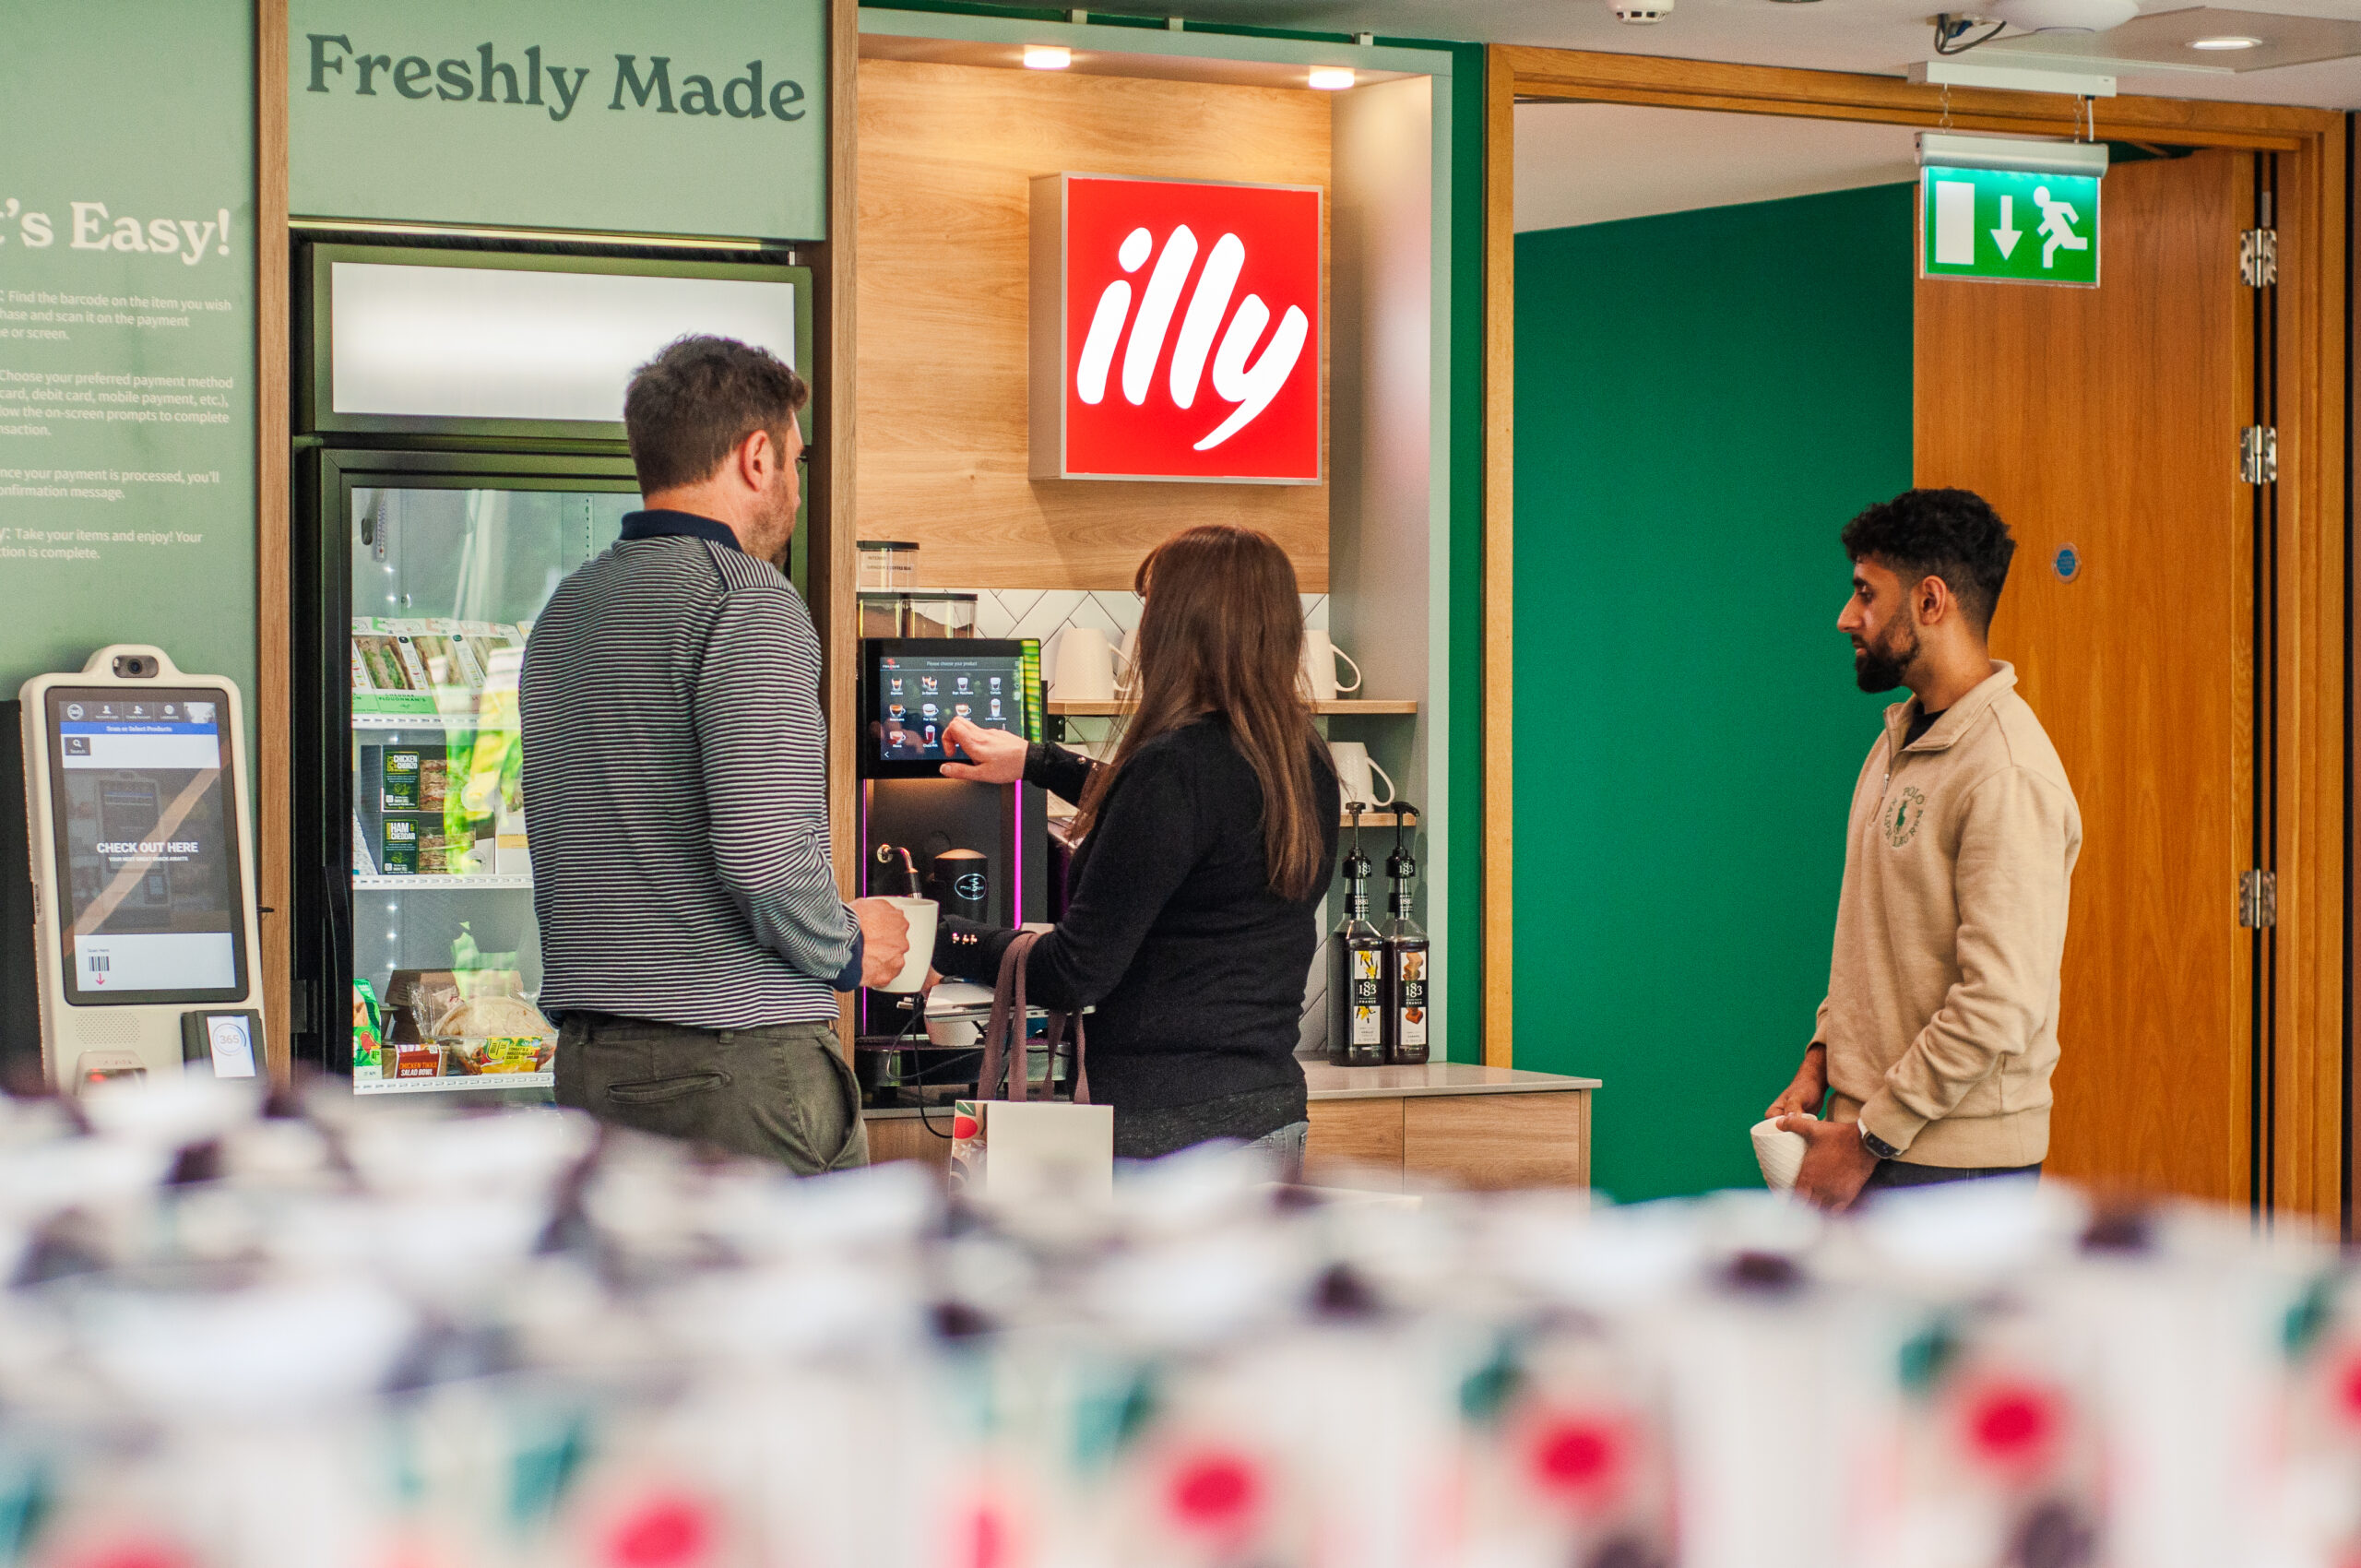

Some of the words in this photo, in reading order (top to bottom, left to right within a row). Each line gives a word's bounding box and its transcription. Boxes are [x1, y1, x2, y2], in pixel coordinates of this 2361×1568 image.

[306, 33, 589, 122] Freshly
[608, 54, 807, 122] Made
[0, 197, 53, 248] 's
[70, 200, 230, 266] Easy!
[8, 291, 35, 303] Find
[38, 291, 57, 303] the
[60, 291, 110, 306] barcode
[112, 296, 127, 306] on
[130, 295, 148, 307] the
[151, 296, 178, 309] item
[181, 301, 202, 312] you
[205, 299, 232, 311] wish
[30, 310, 53, 322] and
[55, 313, 83, 323] scan
[86, 312, 95, 324] it
[97, 314, 112, 324] on
[114, 313, 134, 325] the
[136, 315, 190, 328] payment
[11, 328, 25, 338] or
[27, 329, 70, 339] screen.
[1076, 224, 1309, 451] illy
[0, 369, 42, 382] Choose
[44, 374, 73, 385] your
[76, 372, 131, 386] preferred
[133, 375, 185, 388] payment
[188, 375, 233, 388] method
[31, 388, 64, 400] debit
[65, 389, 96, 403] card,
[98, 390, 139, 403] mobile
[141, 394, 198, 407] payment,
[200, 393, 229, 408] etc.),
[22, 406, 42, 418] the
[44, 409, 104, 420] on-screen
[106, 410, 158, 424] prompts
[159, 410, 172, 422] to
[174, 411, 230, 425] complete
[24, 469, 53, 481] your
[54, 469, 107, 483] payment
[109, 469, 119, 481] is
[121, 470, 185, 483] processed,
[187, 470, 220, 485] you'll
[70, 488, 125, 502] message.
[15, 528, 44, 540] Take
[46, 531, 74, 543] your
[76, 529, 110, 541] items
[113, 529, 135, 542] and
[136, 530, 173, 545] enjoy!
[175, 530, 203, 543] Your
[0, 546, 26, 558] tion
[28, 546, 38, 558] is
[40, 547, 101, 561] complete.
[391, 822, 409, 833] HAM
[96, 842, 138, 853] CHECK
[139, 842, 165, 853] OUT
[167, 842, 199, 853] HERE
[219, 1034, 240, 1044] 365
